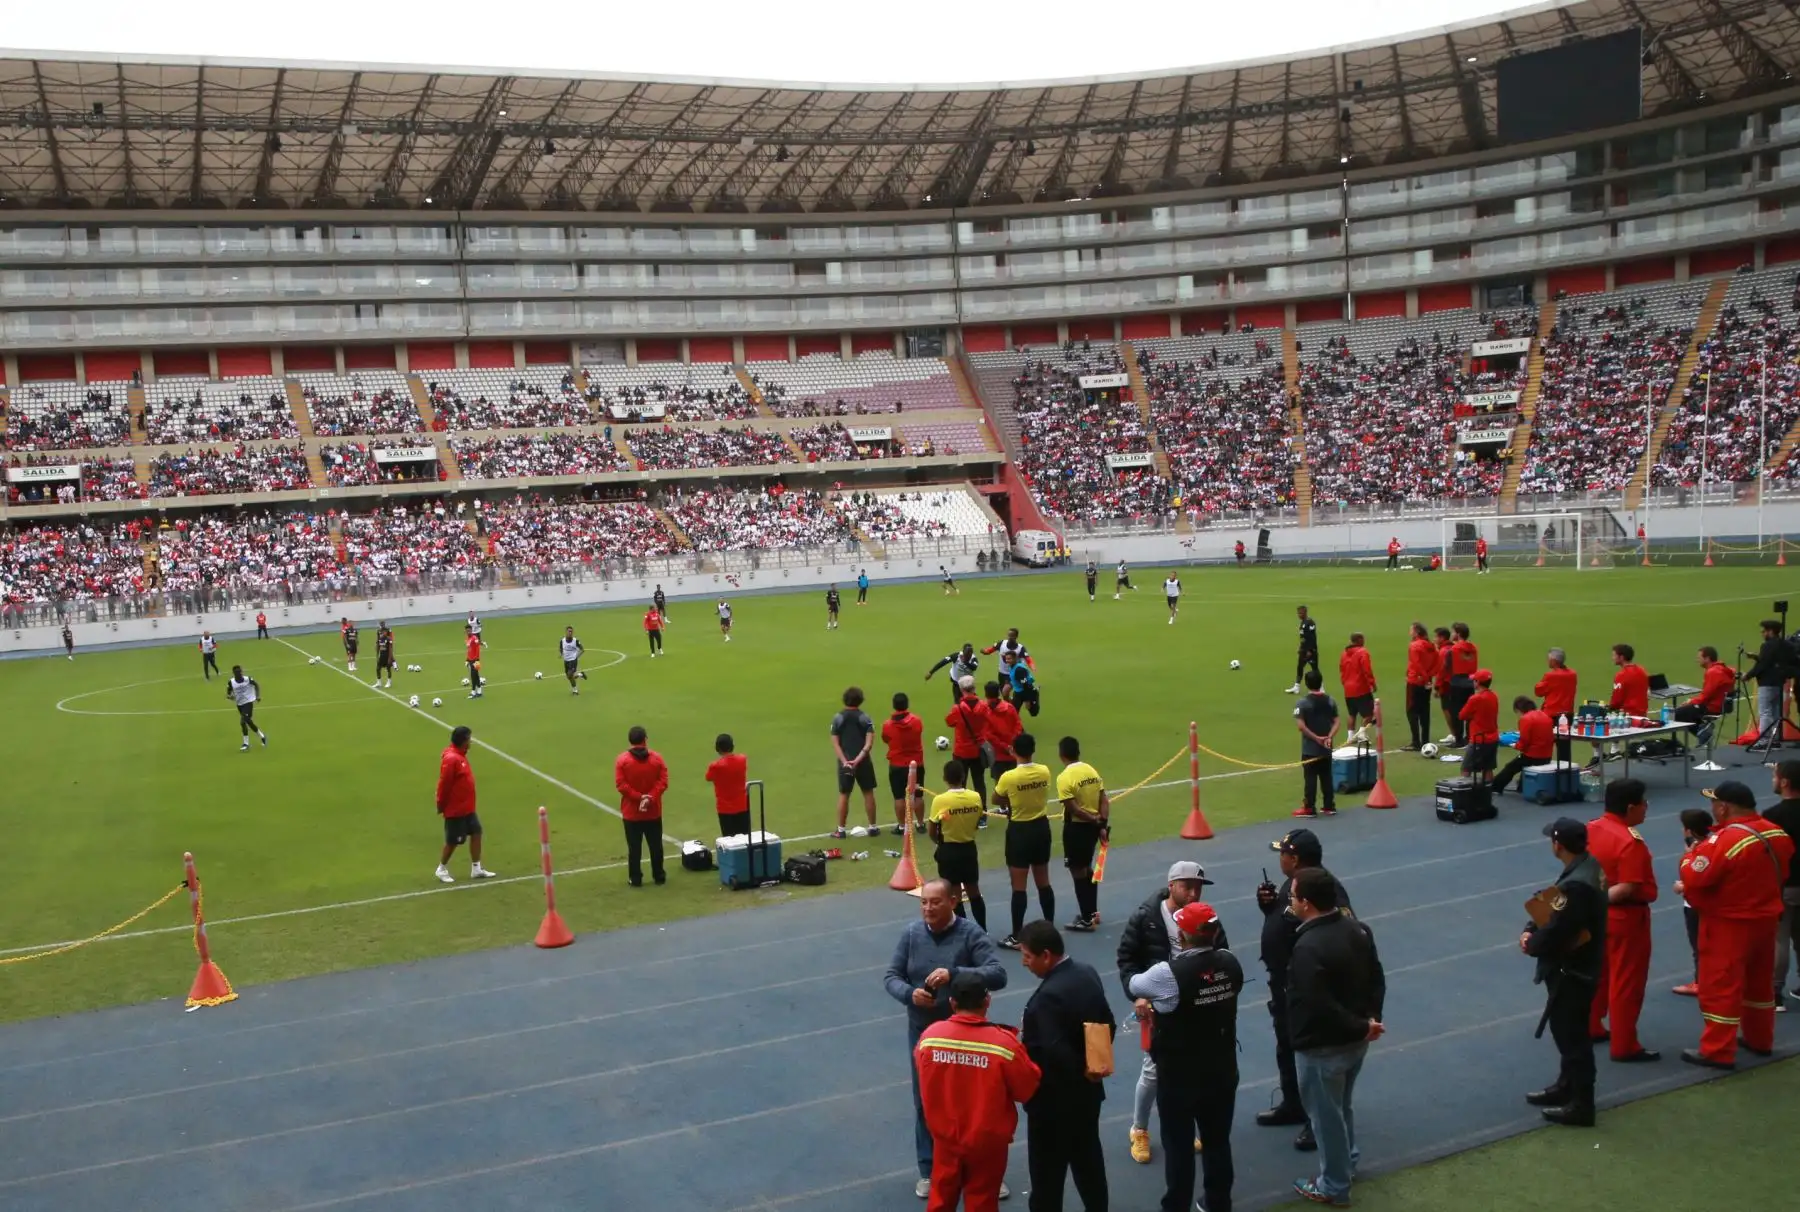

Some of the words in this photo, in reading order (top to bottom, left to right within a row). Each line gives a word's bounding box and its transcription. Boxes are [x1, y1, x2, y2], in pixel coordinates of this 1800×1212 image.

[1465, 431, 1506, 440] SALIDA
[23, 468, 65, 476] SALIDA
[1016, 780, 1048, 792] umbro
[949, 805, 979, 816] umbro
[932, 1049, 989, 1069] BOMBERO
